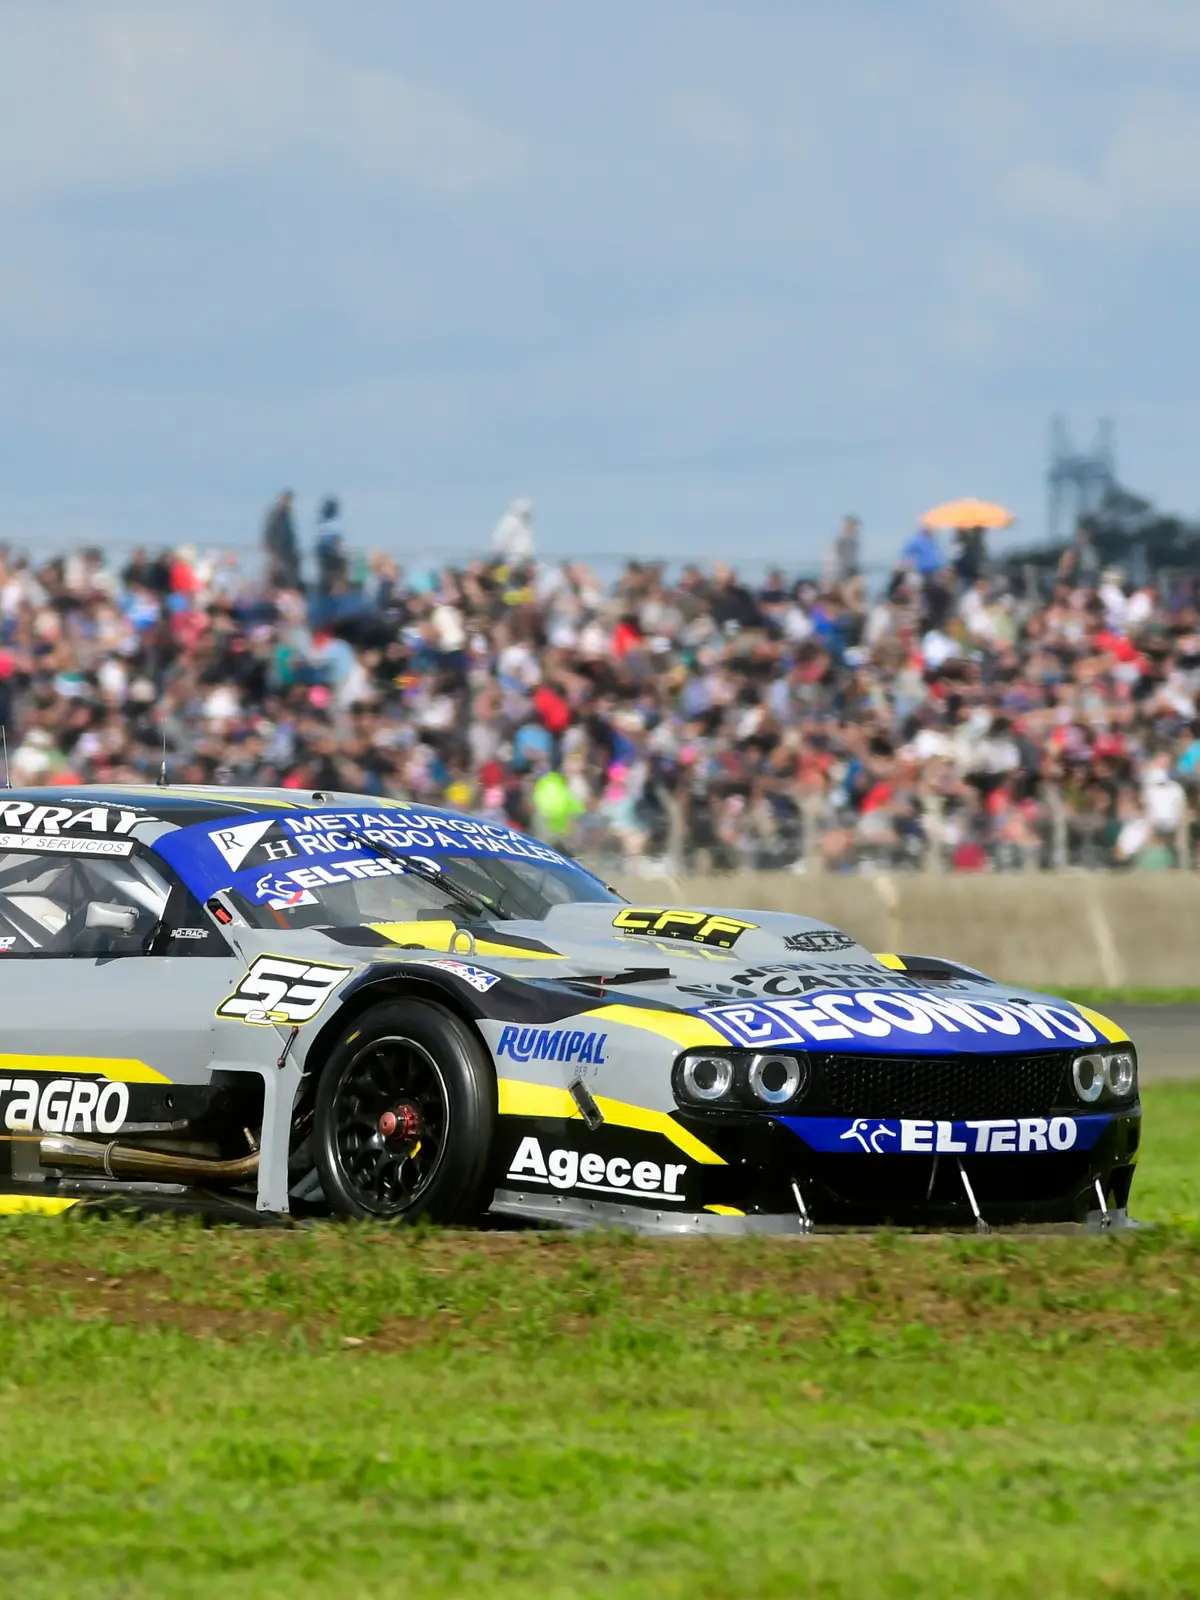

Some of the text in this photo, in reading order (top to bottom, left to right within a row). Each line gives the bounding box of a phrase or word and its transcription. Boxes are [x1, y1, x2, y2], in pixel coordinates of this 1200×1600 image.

[20, 836, 31, 847] Y
[36, 838, 125, 853] SERVICIOS
[216, 831, 297, 861] R H
[284, 814, 534, 845] METALURGICA
[435, 831, 468, 849] A.
[464, 834, 576, 870] HALLER
[624, 927, 731, 948] MOTOS
[216, 953, 355, 1025] 53
[730, 963, 811, 986] NEW
[765, 992, 1097, 1043] ECONOVO
[496, 1025, 608, 1065] RUMIPAL
[509, 1136, 687, 1193] Agecer
